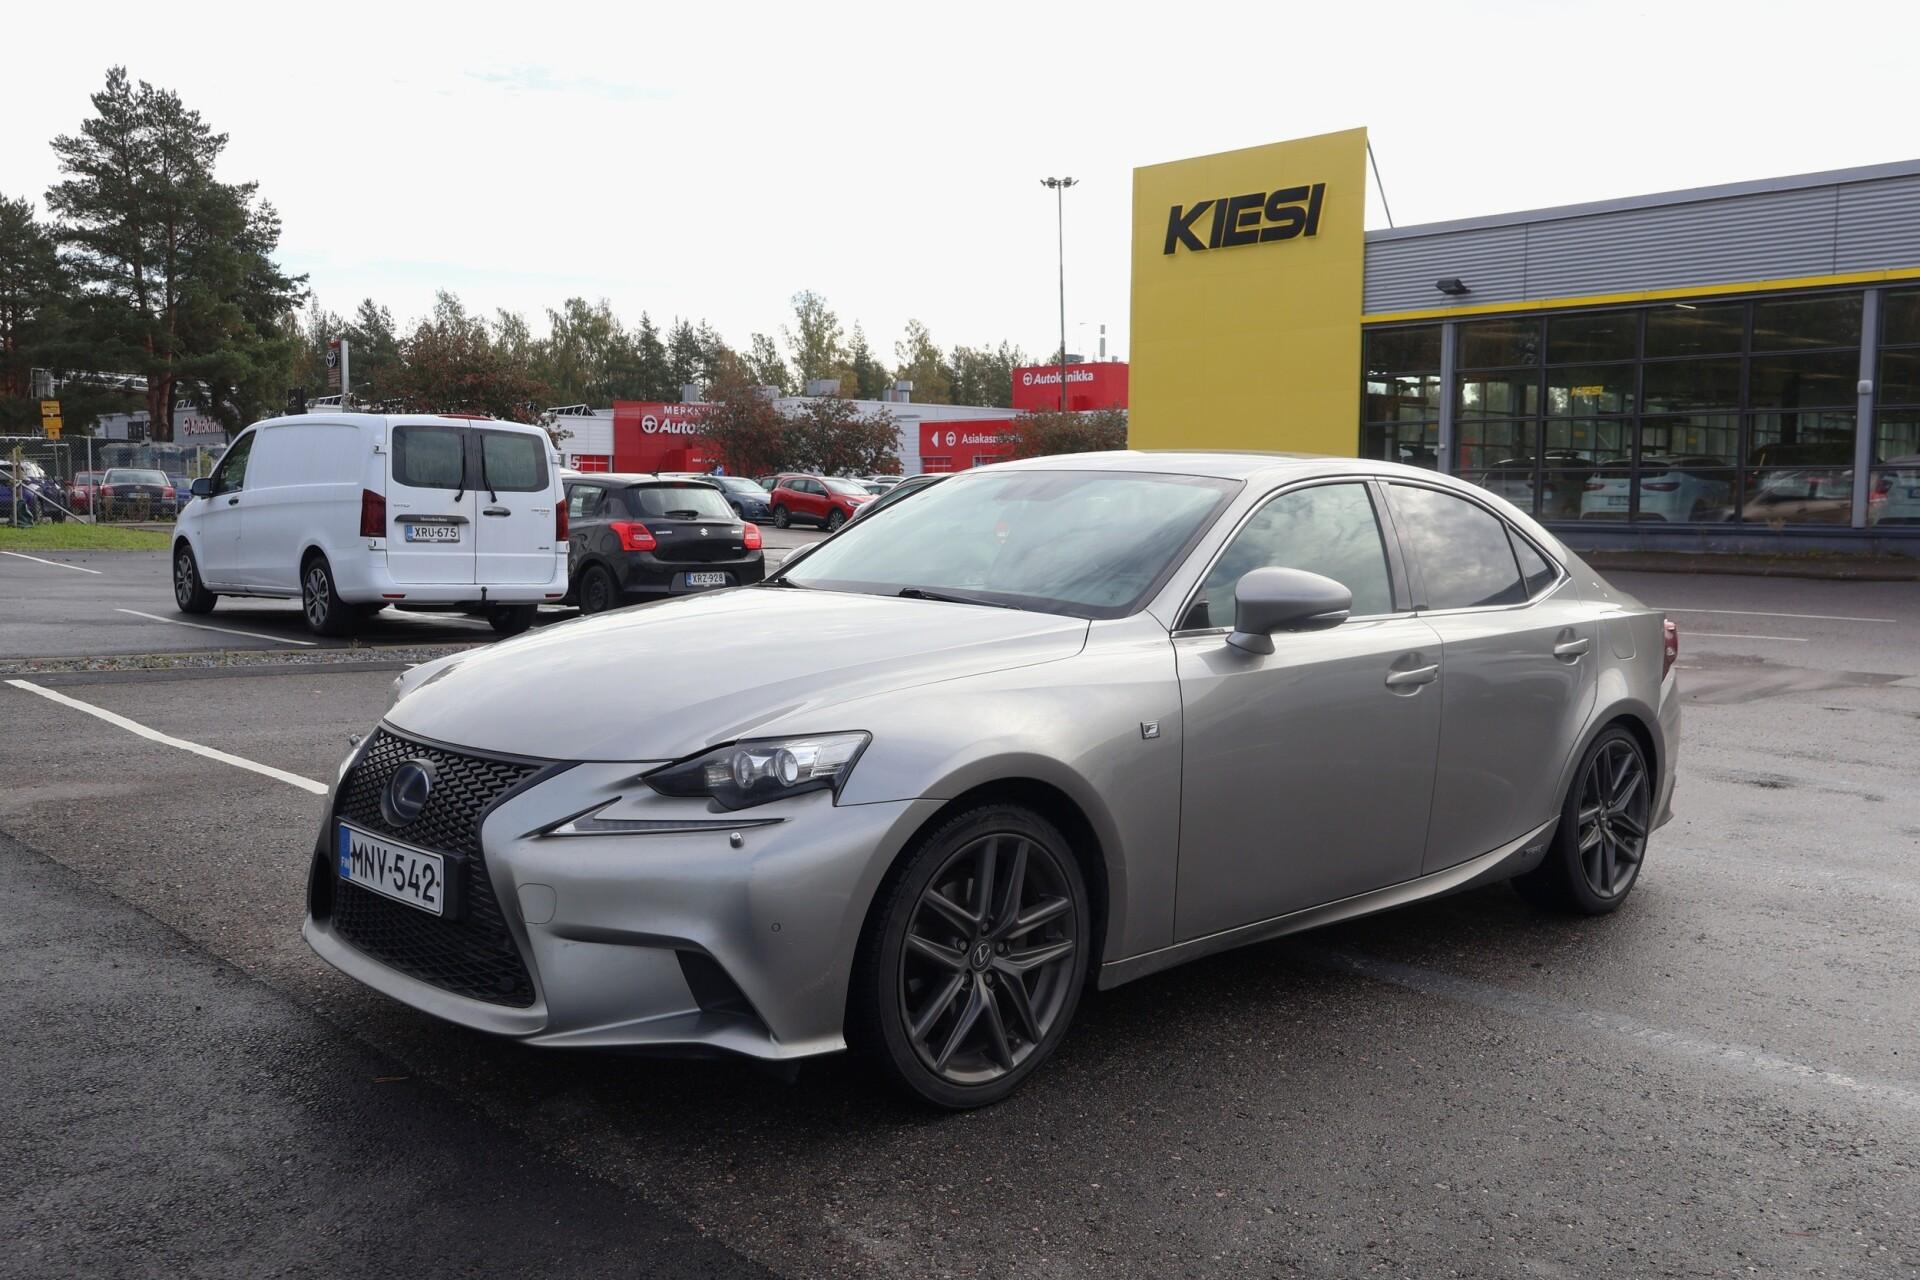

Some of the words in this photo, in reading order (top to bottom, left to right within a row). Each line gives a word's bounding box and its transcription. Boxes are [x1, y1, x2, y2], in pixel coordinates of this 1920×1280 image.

[1163, 183, 1326, 255] KIESI
[1033, 370, 1093, 384] Autokinikka
[571, 456, 580, 469] 5
[415, 528, 456, 537] XRU-675
[352, 840, 435, 903] MNV-542
